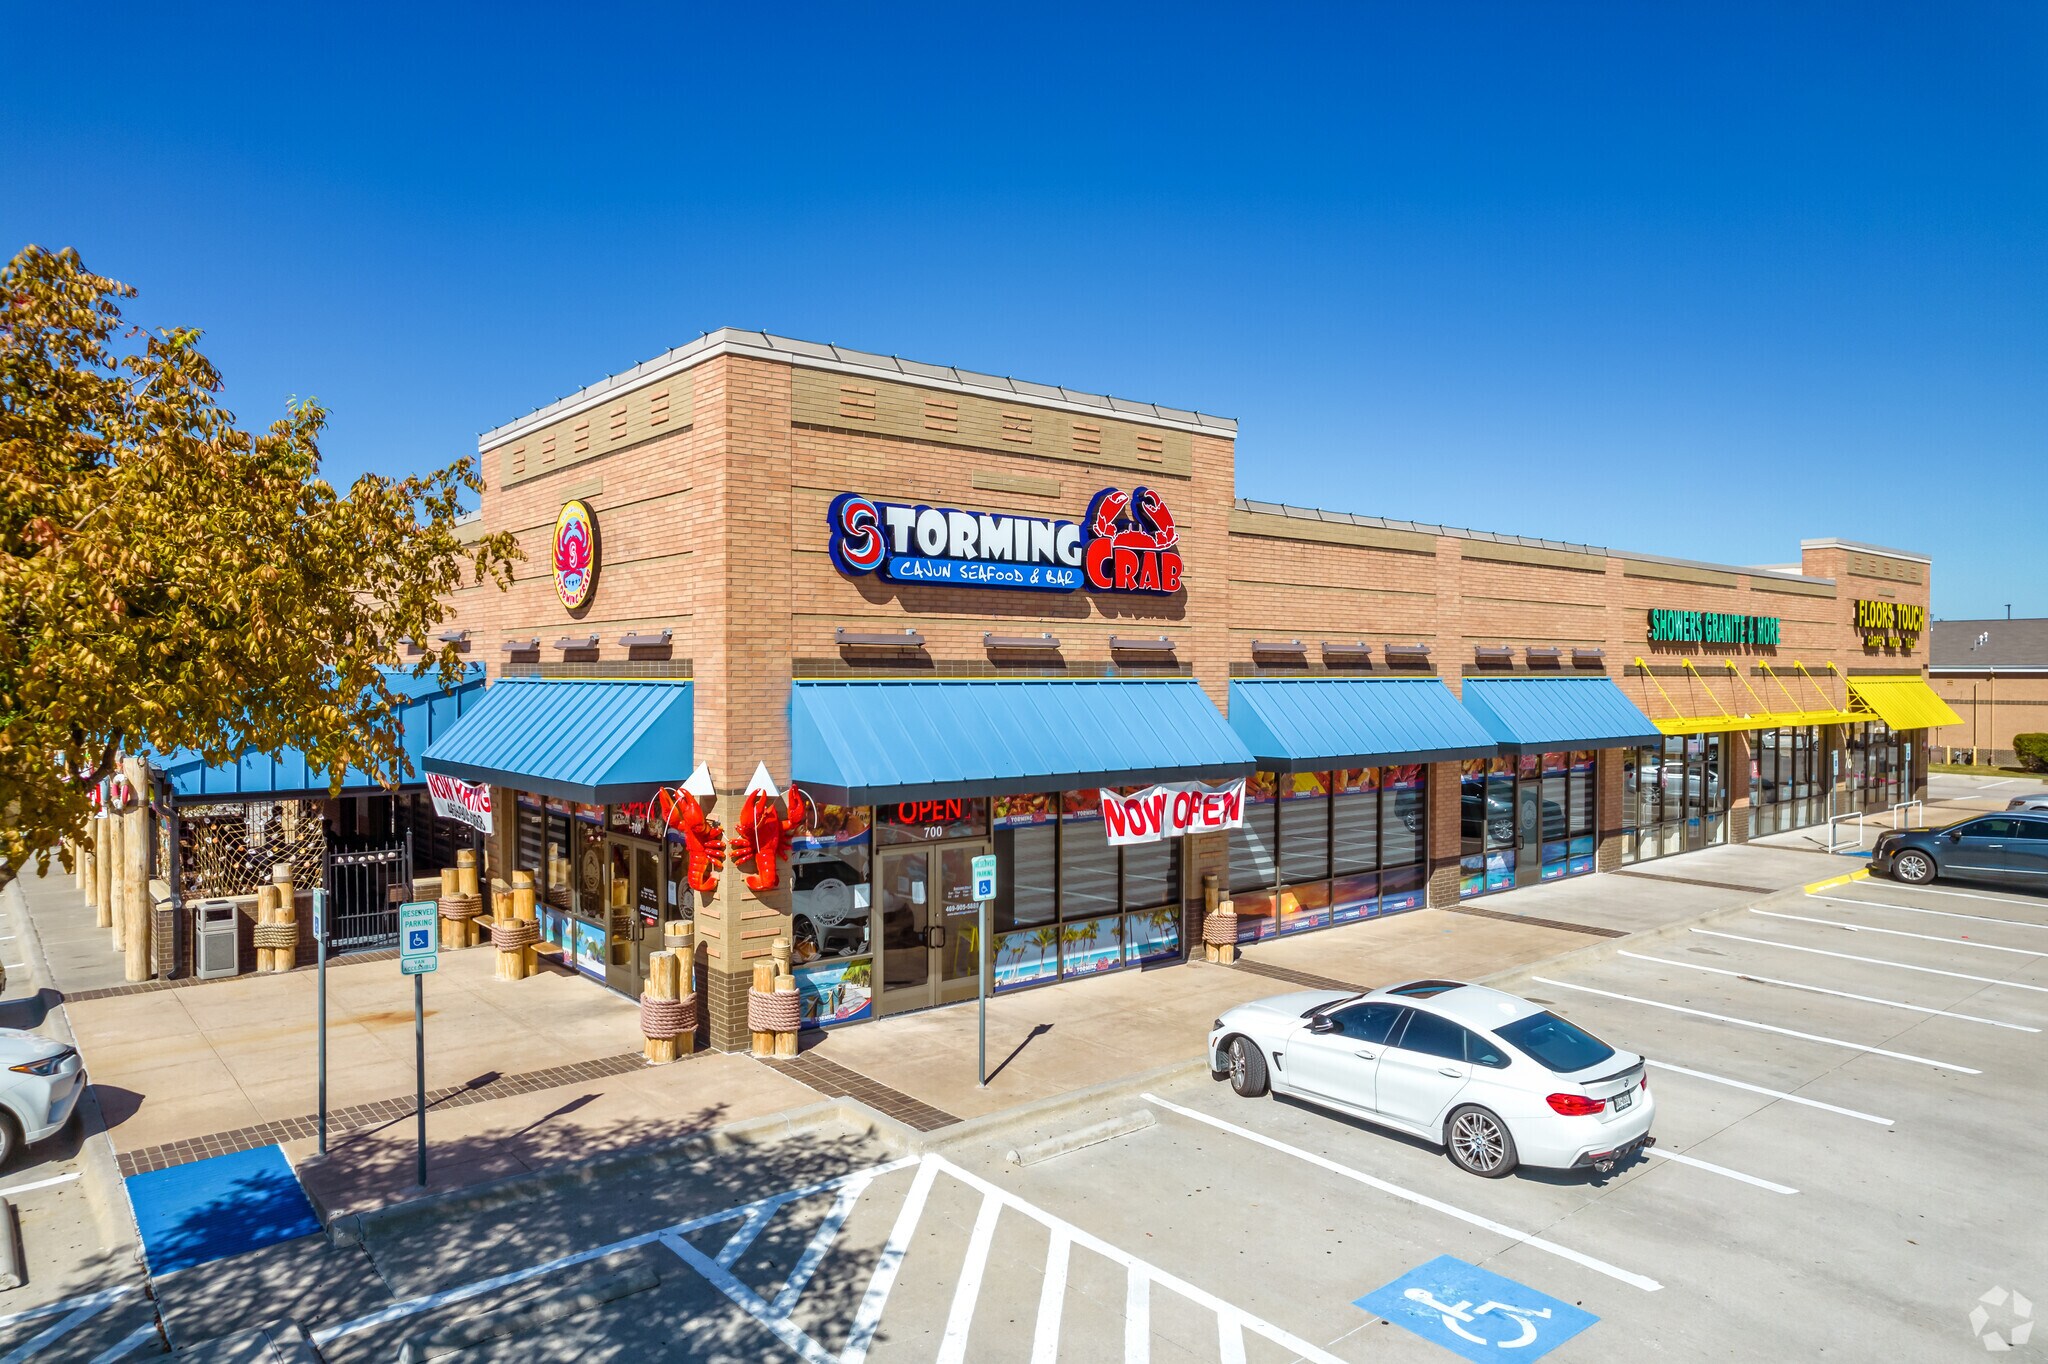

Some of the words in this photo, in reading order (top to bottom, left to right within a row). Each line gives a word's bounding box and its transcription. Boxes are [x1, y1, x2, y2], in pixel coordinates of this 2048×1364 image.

[842, 497, 1083, 571] STORMING
[1086, 537, 1183, 592] CRAB
[900, 559, 951, 579] CAJUN
[959, 564, 1024, 583] SEAFOOD
[1029, 568, 1040, 584] &
[1046, 569, 1075, 586] BAR
[1652, 608, 1703, 642] SHOWERS
[1705, 611, 1745, 644] GRANITE
[1748, 616, 1755, 644] &
[1757, 616, 1780, 645] MORE
[1859, 599, 1893, 629] FLOORS
[1896, 603, 1925, 632] TOUCH
[428, 774, 455, 801] NOW
[898, 797, 962, 825] OPEN
[1103, 793, 1167, 837] NOW
[1173, 788, 1241, 829] OPEN
[923, 825, 943, 839] 700
[402, 908, 435, 918] RESERVED
[404, 919, 433, 928] PARKING
[404, 964, 435, 972] ACCESSIBLE
